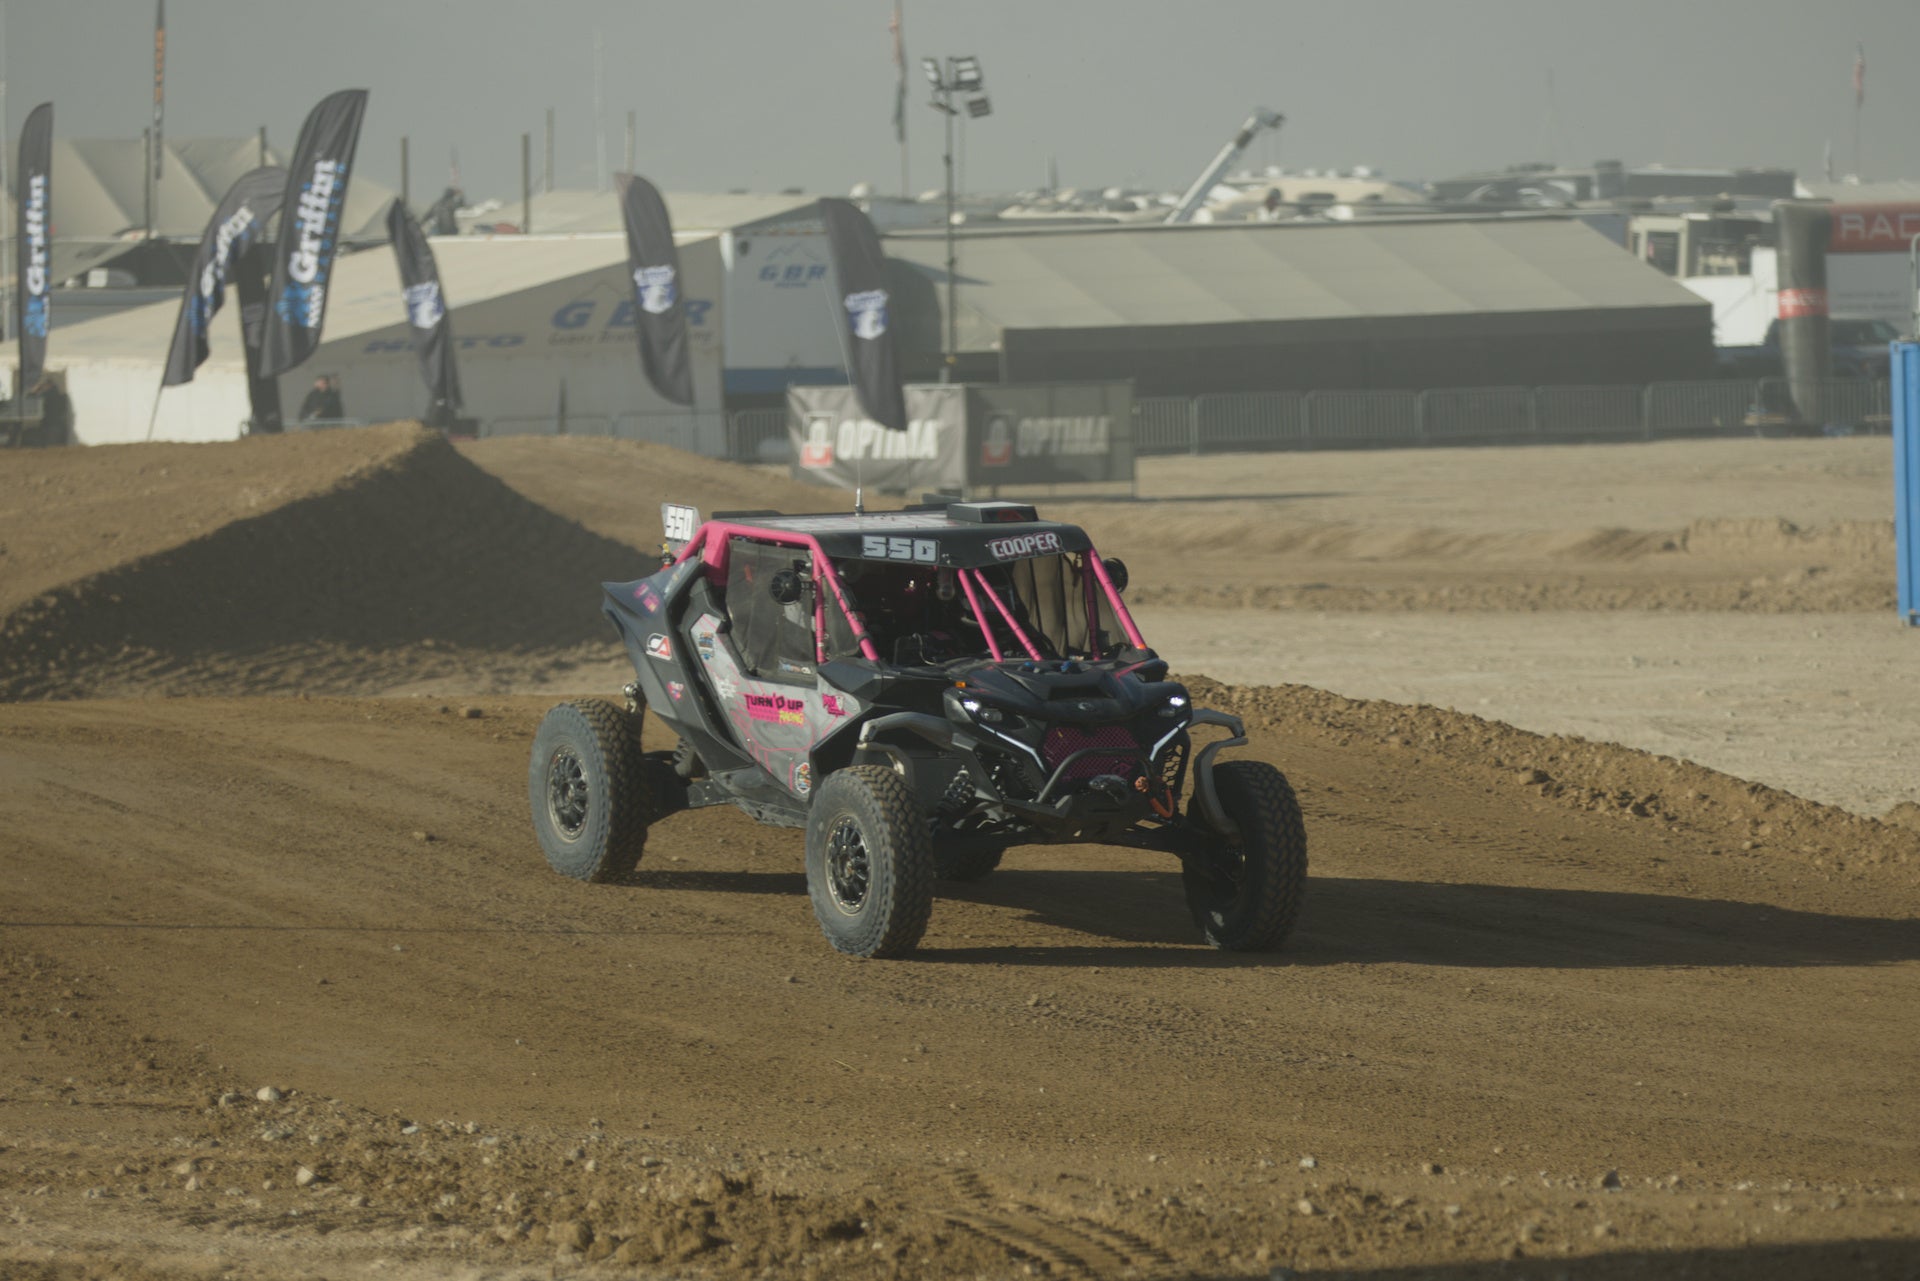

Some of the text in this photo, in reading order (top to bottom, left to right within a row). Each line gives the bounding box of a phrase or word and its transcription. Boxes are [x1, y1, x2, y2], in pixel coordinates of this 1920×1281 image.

[288, 158, 337, 283] Griffin
[863, 535, 938, 562] 550
[787, 699, 804, 710] UP
